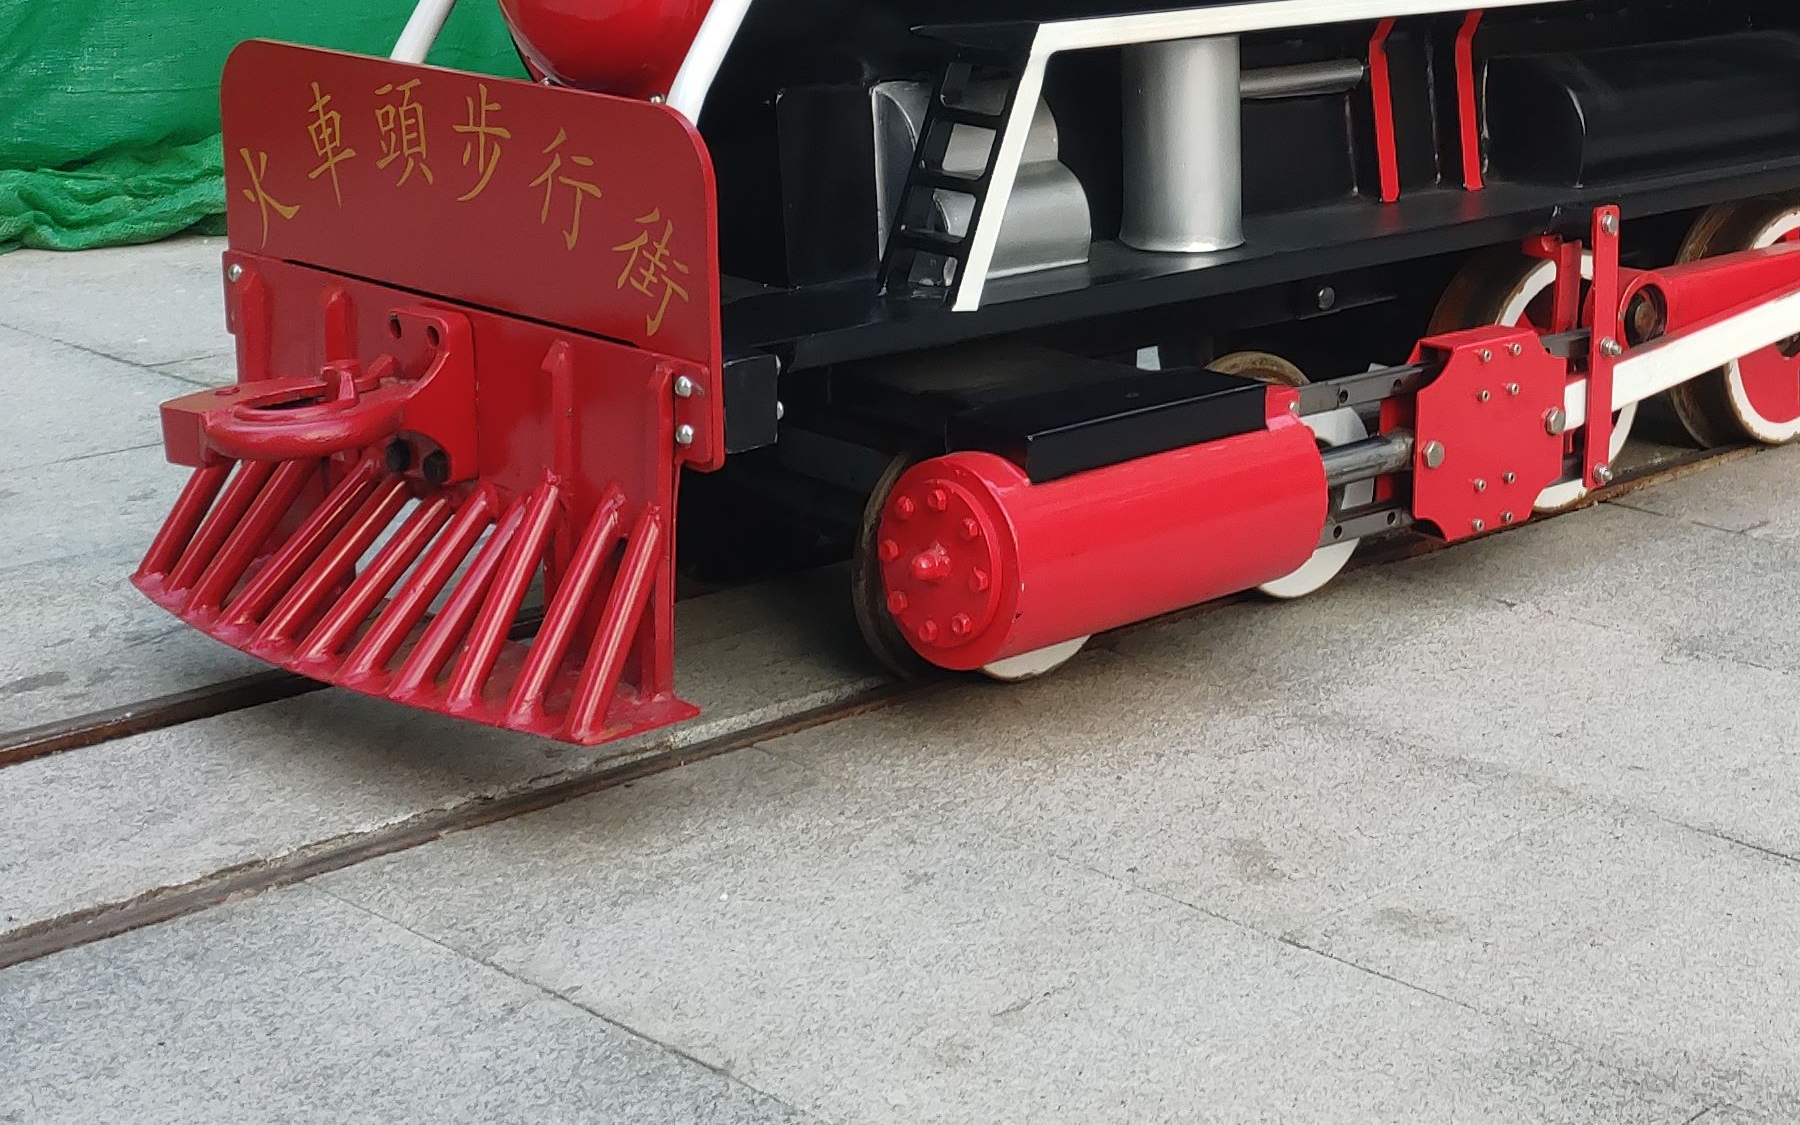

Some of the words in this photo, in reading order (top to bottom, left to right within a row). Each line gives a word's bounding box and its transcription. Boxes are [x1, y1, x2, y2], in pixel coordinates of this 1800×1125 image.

[239, 77, 690, 337] 火車頭步行街
